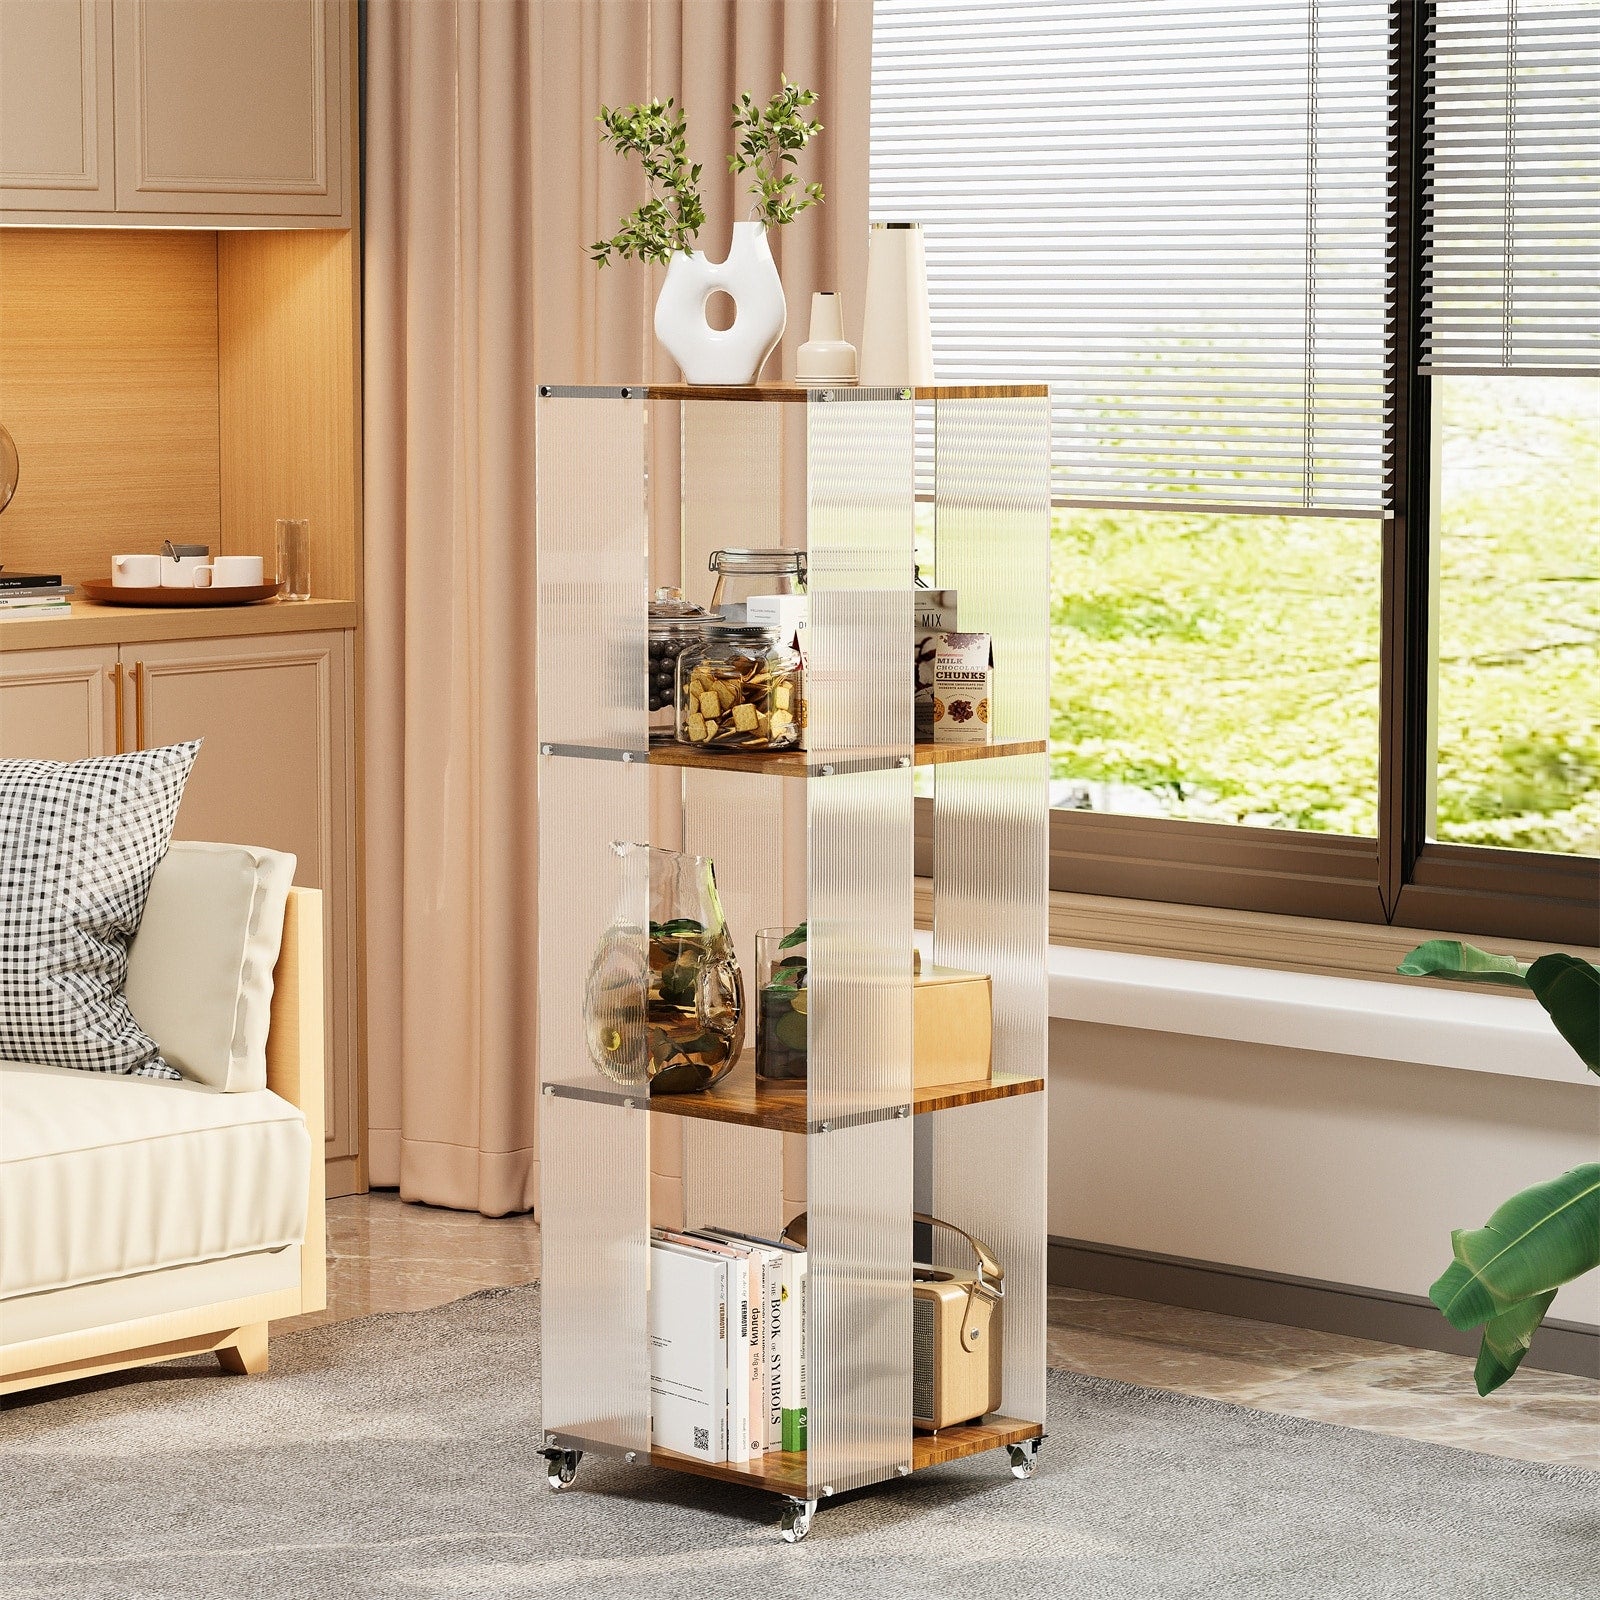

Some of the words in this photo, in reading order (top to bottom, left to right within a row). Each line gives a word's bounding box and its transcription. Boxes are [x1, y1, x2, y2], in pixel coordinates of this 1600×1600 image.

[922, 614, 942, 627] MIX
[936, 672, 986, 680] CHUNKS
[750, 1308, 760, 1346] Киллер
[771, 1300, 781, 1339] BOOK
[771, 1342, 776, 1352] OF
[771, 1354, 781, 1424] SYMBOLS
